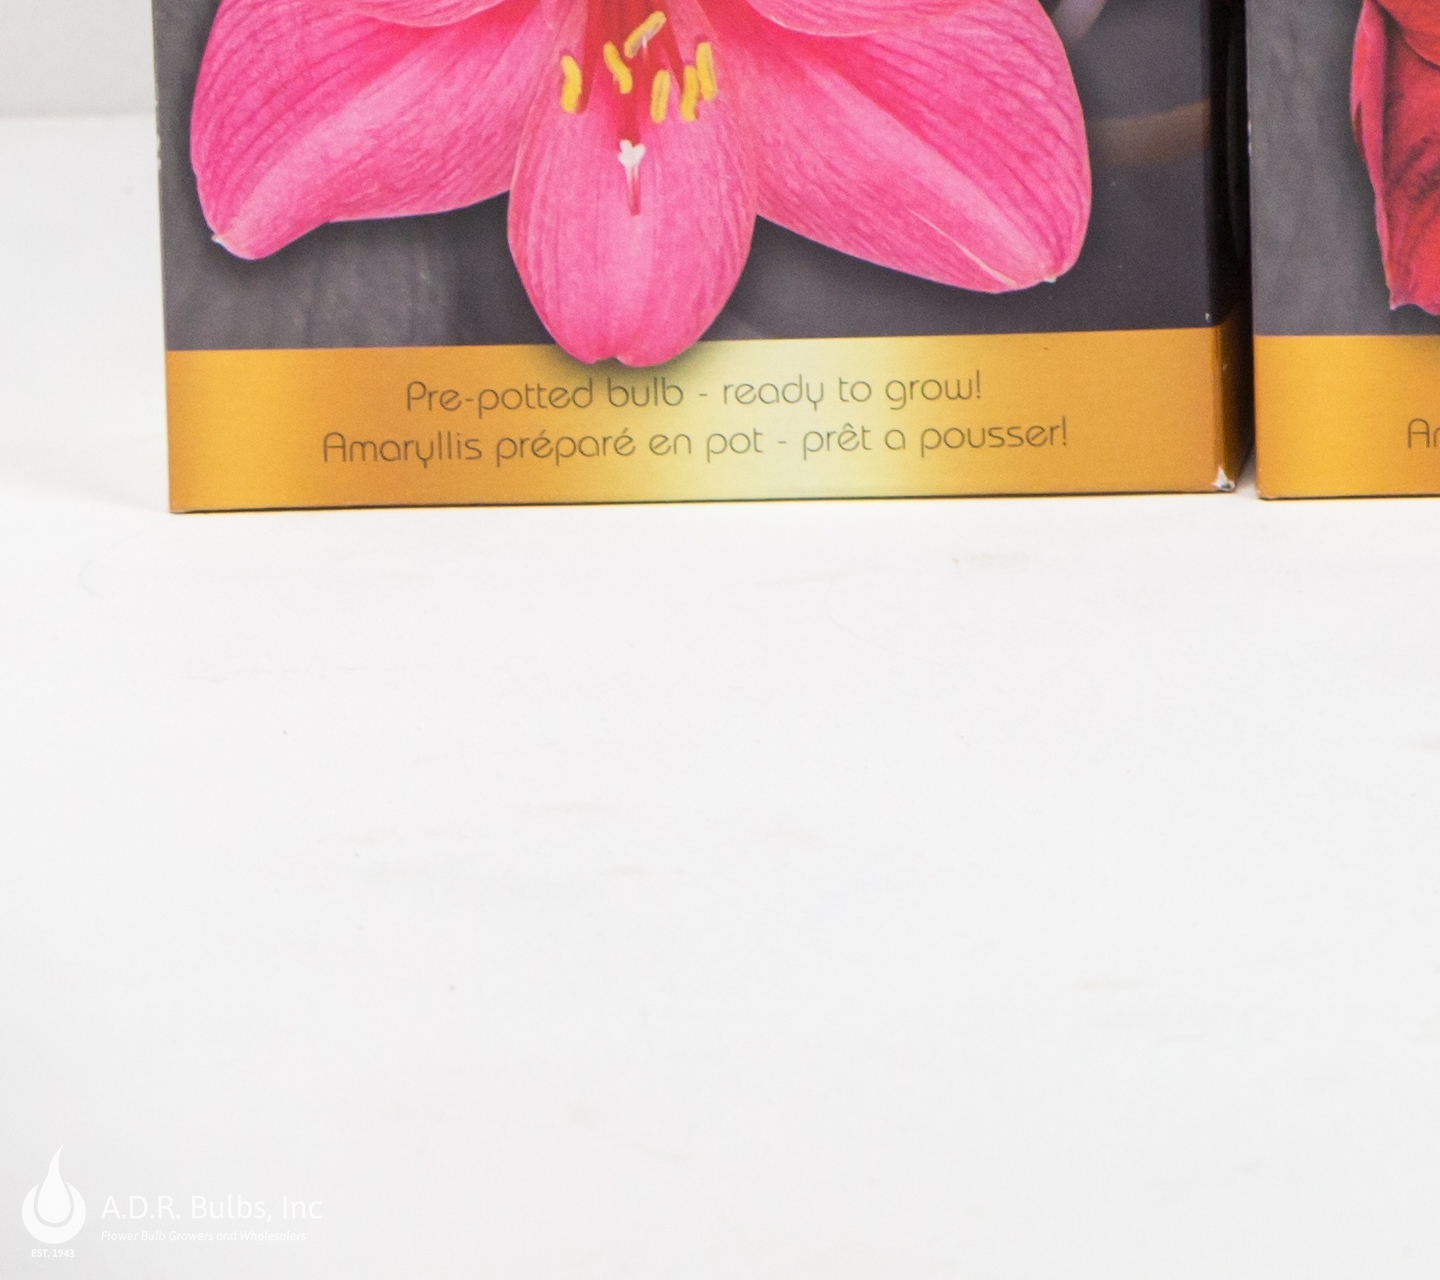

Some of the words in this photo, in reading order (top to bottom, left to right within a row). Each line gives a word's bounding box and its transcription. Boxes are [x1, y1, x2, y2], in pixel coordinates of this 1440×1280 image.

[407, 378, 593, 419] Pre-potted
[608, 376, 684, 408] bulb
[724, 374, 824, 411] ready
[839, 377, 872, 402] to
[886, 370, 981, 410] grow!
[324, 431, 482, 468] Amaryllis
[498, 428, 635, 467] préparé
[649, 434, 691, 456] en
[707, 427, 763, 463] pot
[803, 423, 872, 461] prêt
[885, 429, 905, 450] a
[921, 416, 1066, 458] pousser!
